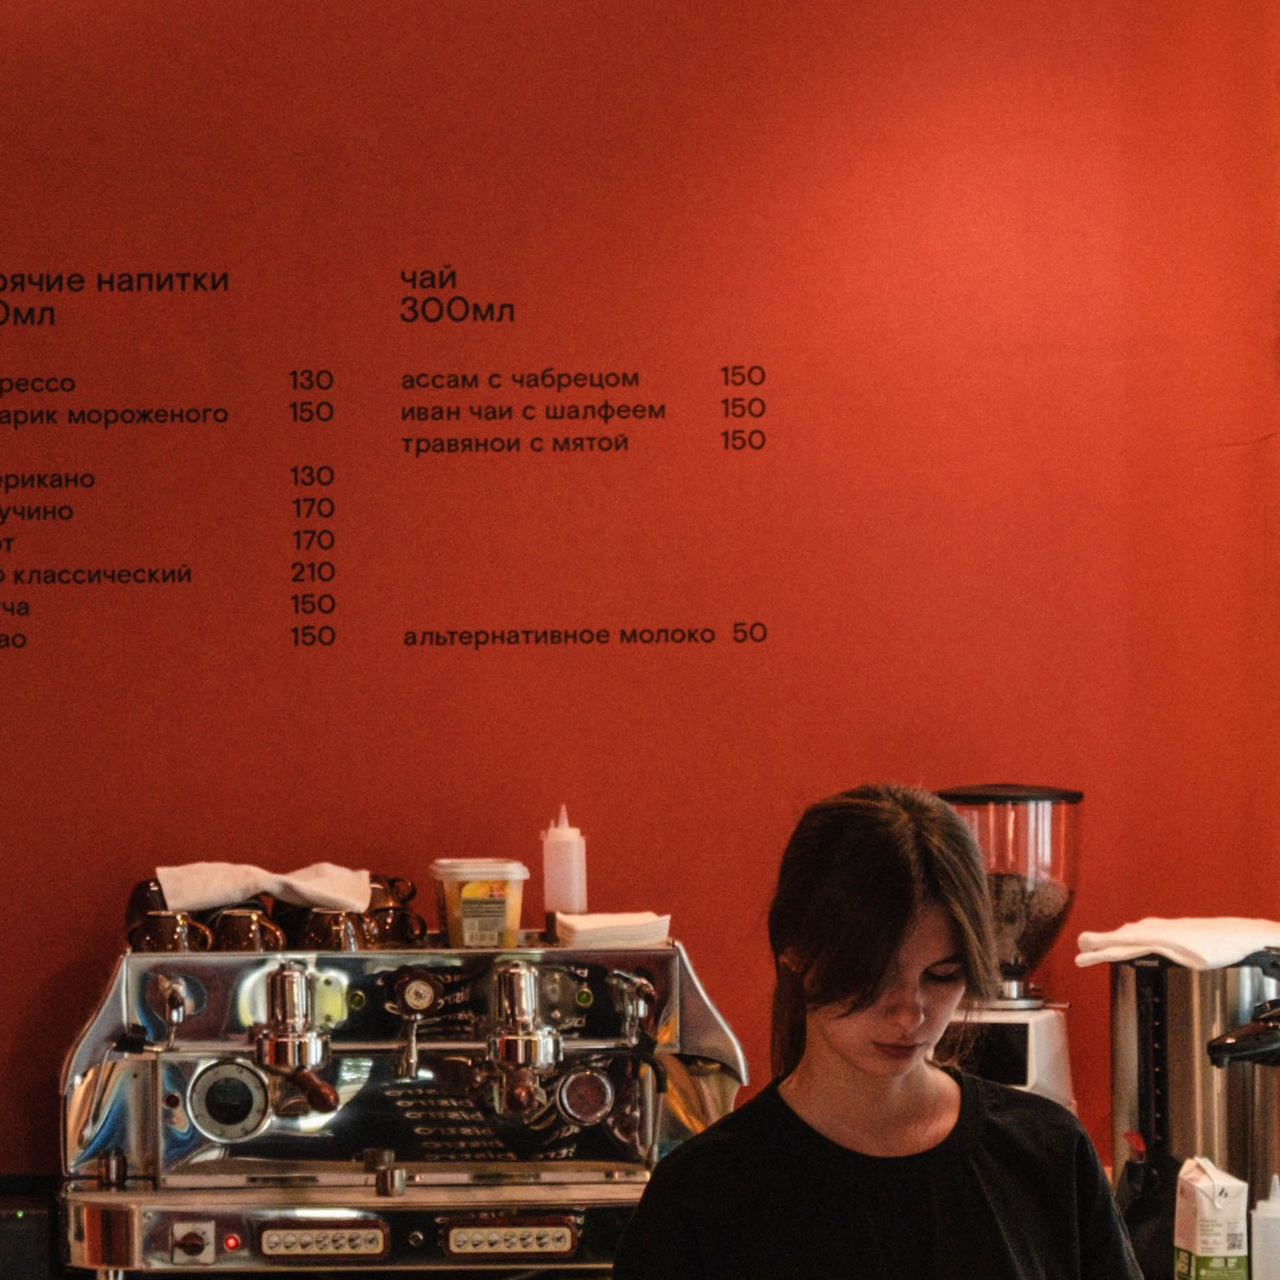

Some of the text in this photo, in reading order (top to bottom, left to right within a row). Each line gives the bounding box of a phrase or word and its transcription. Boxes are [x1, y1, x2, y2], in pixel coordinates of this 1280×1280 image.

[96, 271, 230, 293] напитки
[400, 264, 457, 290] чай
[400, 295, 516, 324] 300мл
[289, 369, 334, 391] 130
[401, 365, 766, 393] ассам с чабрецом 150
[67, 407, 229, 431] мороженого
[289, 400, 335, 423] 150
[401, 405, 461, 422] иван
[521, 405, 536, 421] с
[545, 399, 666, 425] шалфеем
[721, 397, 766, 419] 150
[529, 436, 543, 453] с
[551, 433, 629, 452] мятой
[721, 429, 766, 451] 150
[290, 464, 335, 487] 130
[292, 497, 336, 519] 170
[293, 529, 336, 551] 170
[13, 563, 192, 585] классический
[290, 561, 336, 583] 210
[291, 593, 337, 615] 150
[290, 624, 337, 647] 150
[403, 621, 768, 651] альтернативное молоко 50
